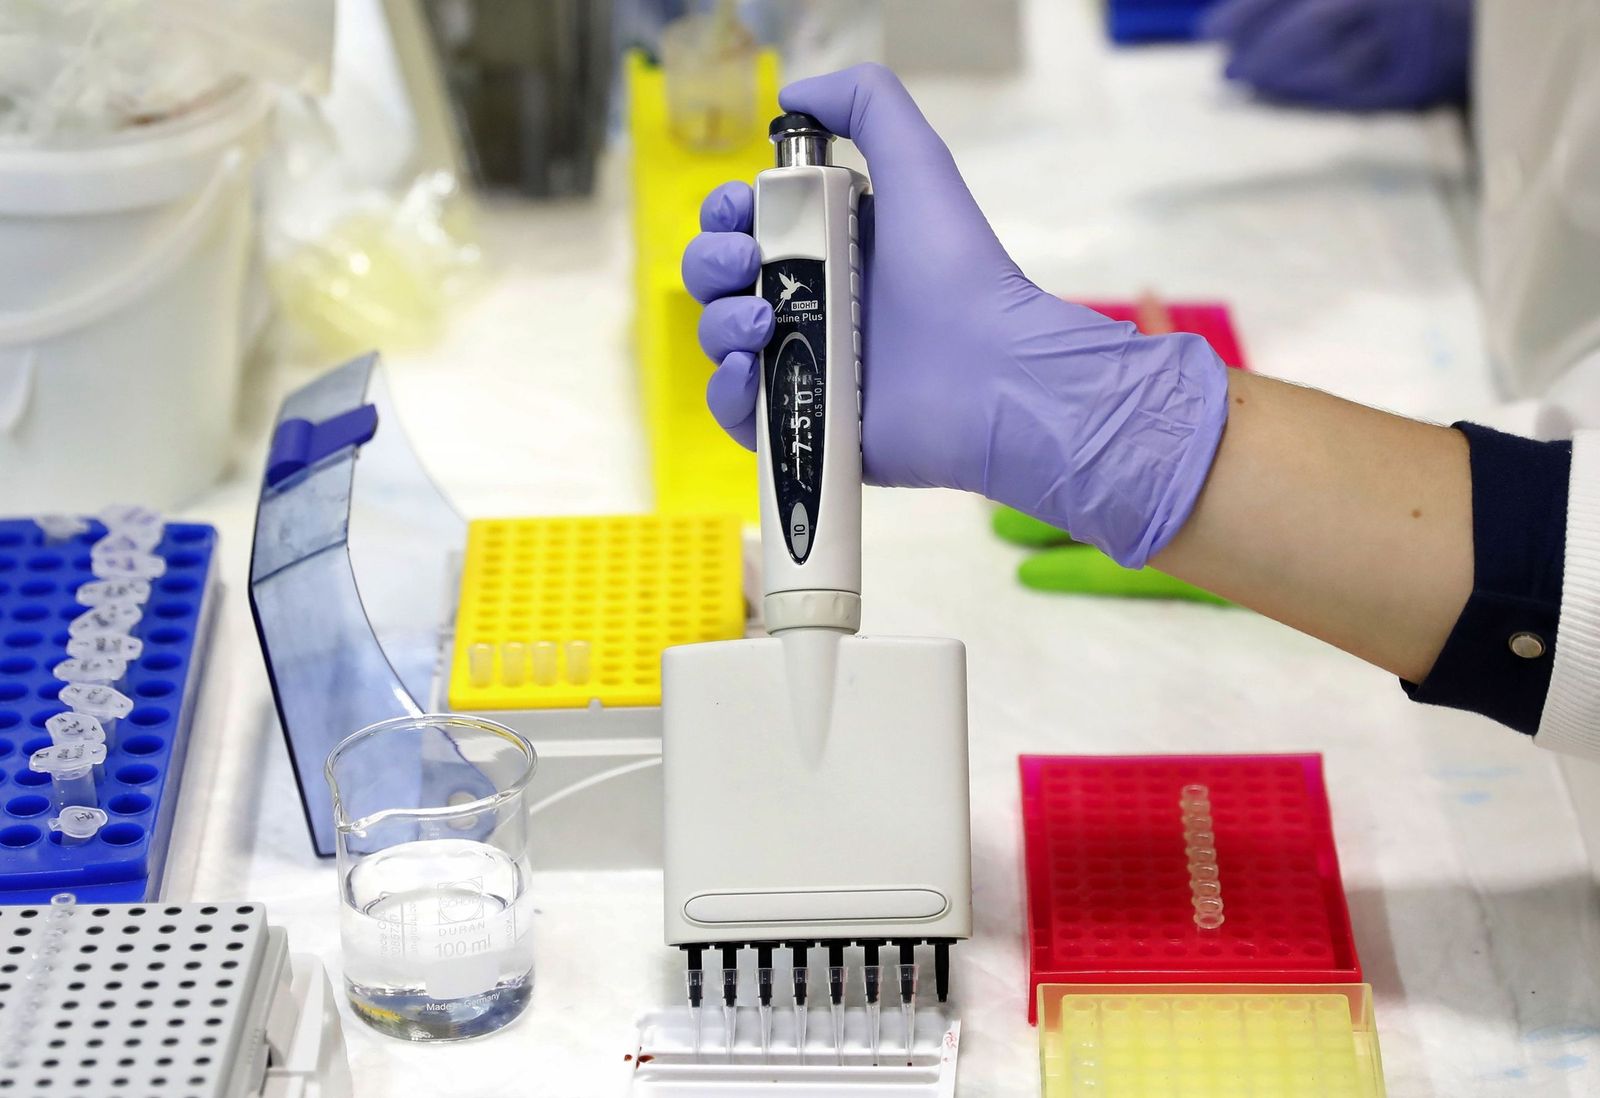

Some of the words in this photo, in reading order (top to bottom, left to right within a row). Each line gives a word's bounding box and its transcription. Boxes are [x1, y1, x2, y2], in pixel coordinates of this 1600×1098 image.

[792, 301, 818, 310] BIOHIT
[802, 312, 823, 322] Plus
[815, 387, 822, 396] 10
[815, 404, 823, 417] 0.5
[794, 524, 806, 537] 10
[438, 920, 485, 936] DURAN
[434, 940, 466, 957] 100
[472, 933, 491, 953] ml
[426, 1002, 453, 1011] Made
